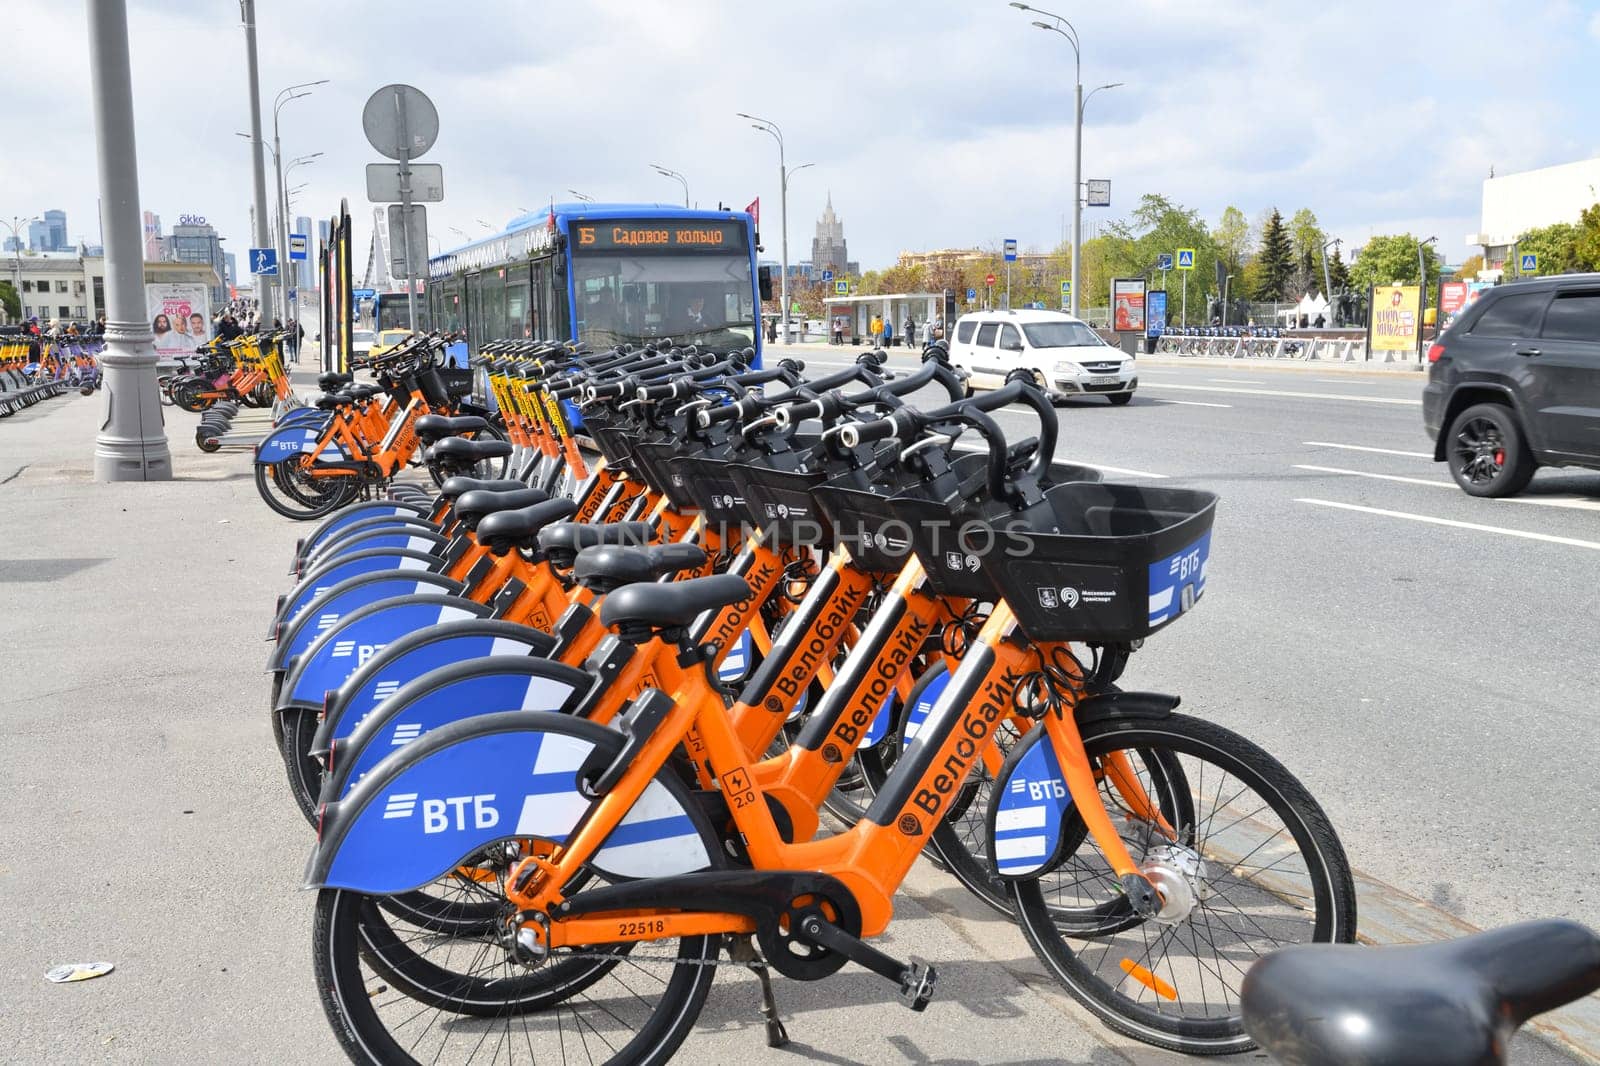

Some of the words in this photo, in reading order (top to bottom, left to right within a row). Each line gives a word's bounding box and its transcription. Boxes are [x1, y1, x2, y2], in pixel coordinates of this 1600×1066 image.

[578, 227, 595, 244] Б
[612, 227, 669, 245] Садовое
[676, 229, 722, 245] кольцо
[279, 440, 298, 451] ВТБ
[579, 483, 609, 524] обайк
[1180, 548, 1200, 580] ВТБ
[711, 562, 775, 651] елобайк
[776, 584, 862, 698] Велобайк
[834, 616, 929, 745] Велобайк
[913, 665, 1020, 817] Велобайк
[734, 790, 755, 808] 2.0
[1028, 779, 1067, 801] ВТБ
[422, 793, 500, 834] ВТБ
[619, 920, 664, 936] 22518
